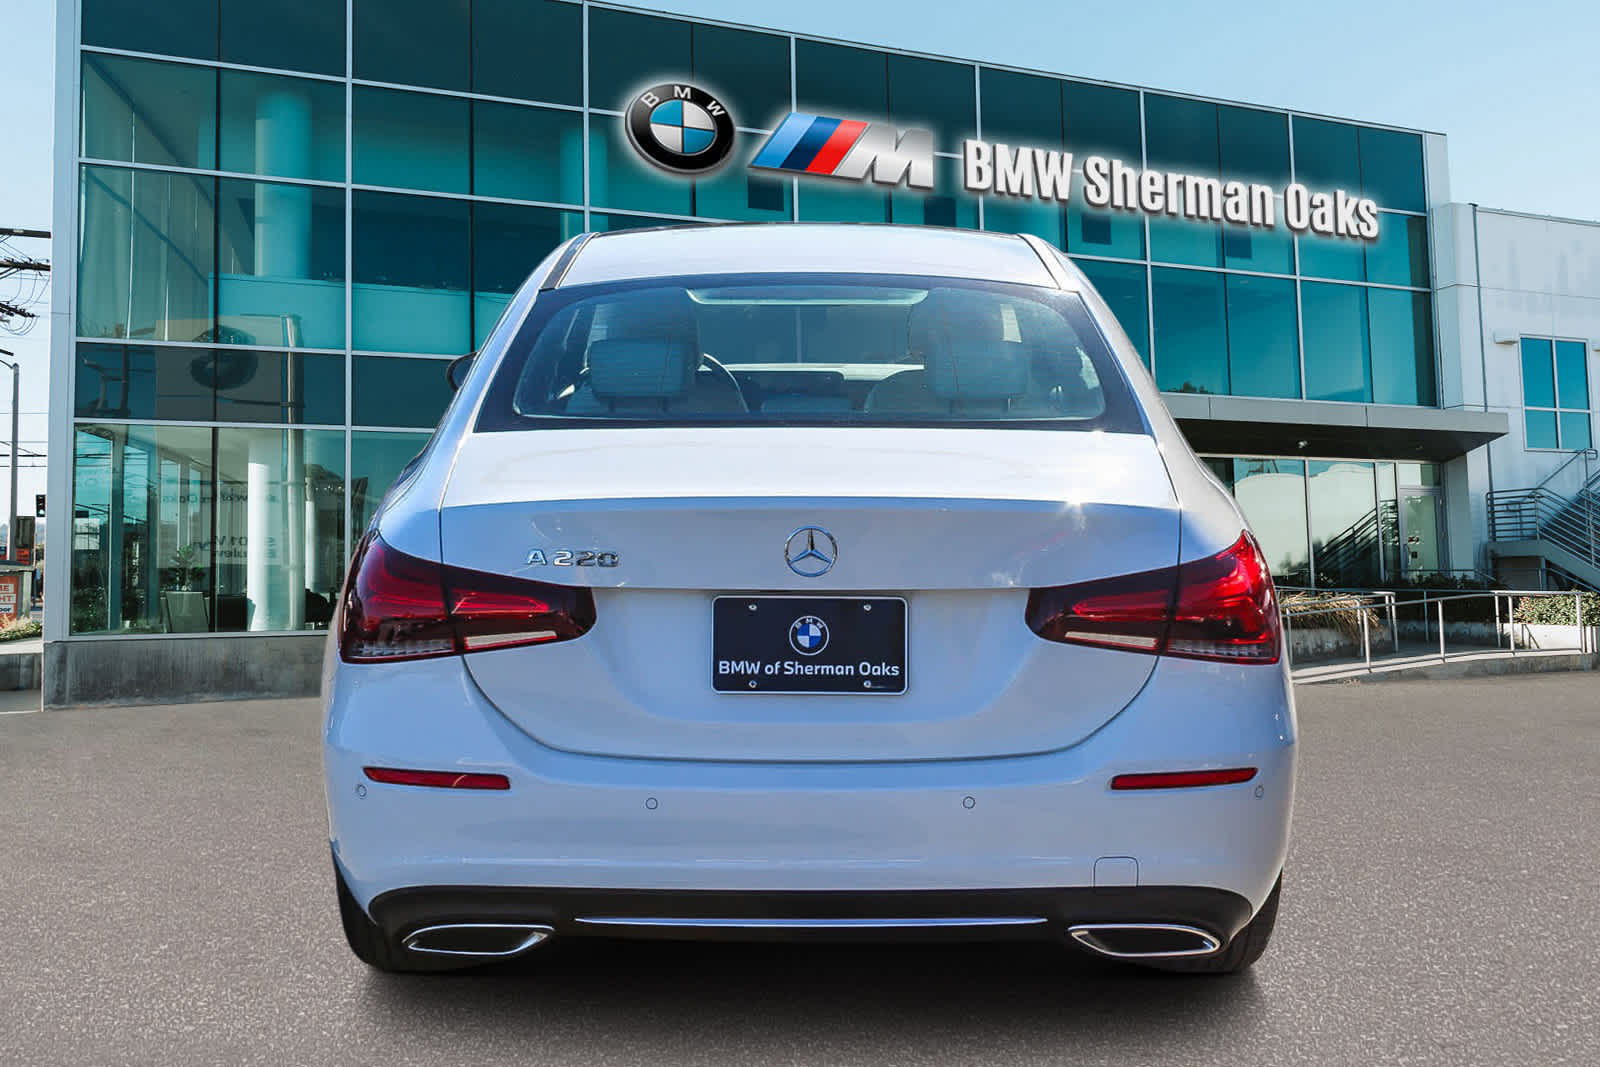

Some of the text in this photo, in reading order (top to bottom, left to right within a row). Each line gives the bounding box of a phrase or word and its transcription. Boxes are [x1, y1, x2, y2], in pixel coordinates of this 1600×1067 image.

[640, 85, 725, 117] BMW
[963, 139, 1378, 241] BMW Sherman Oaks
[719, 661, 899, 676] BMW of Sherman Oaks
